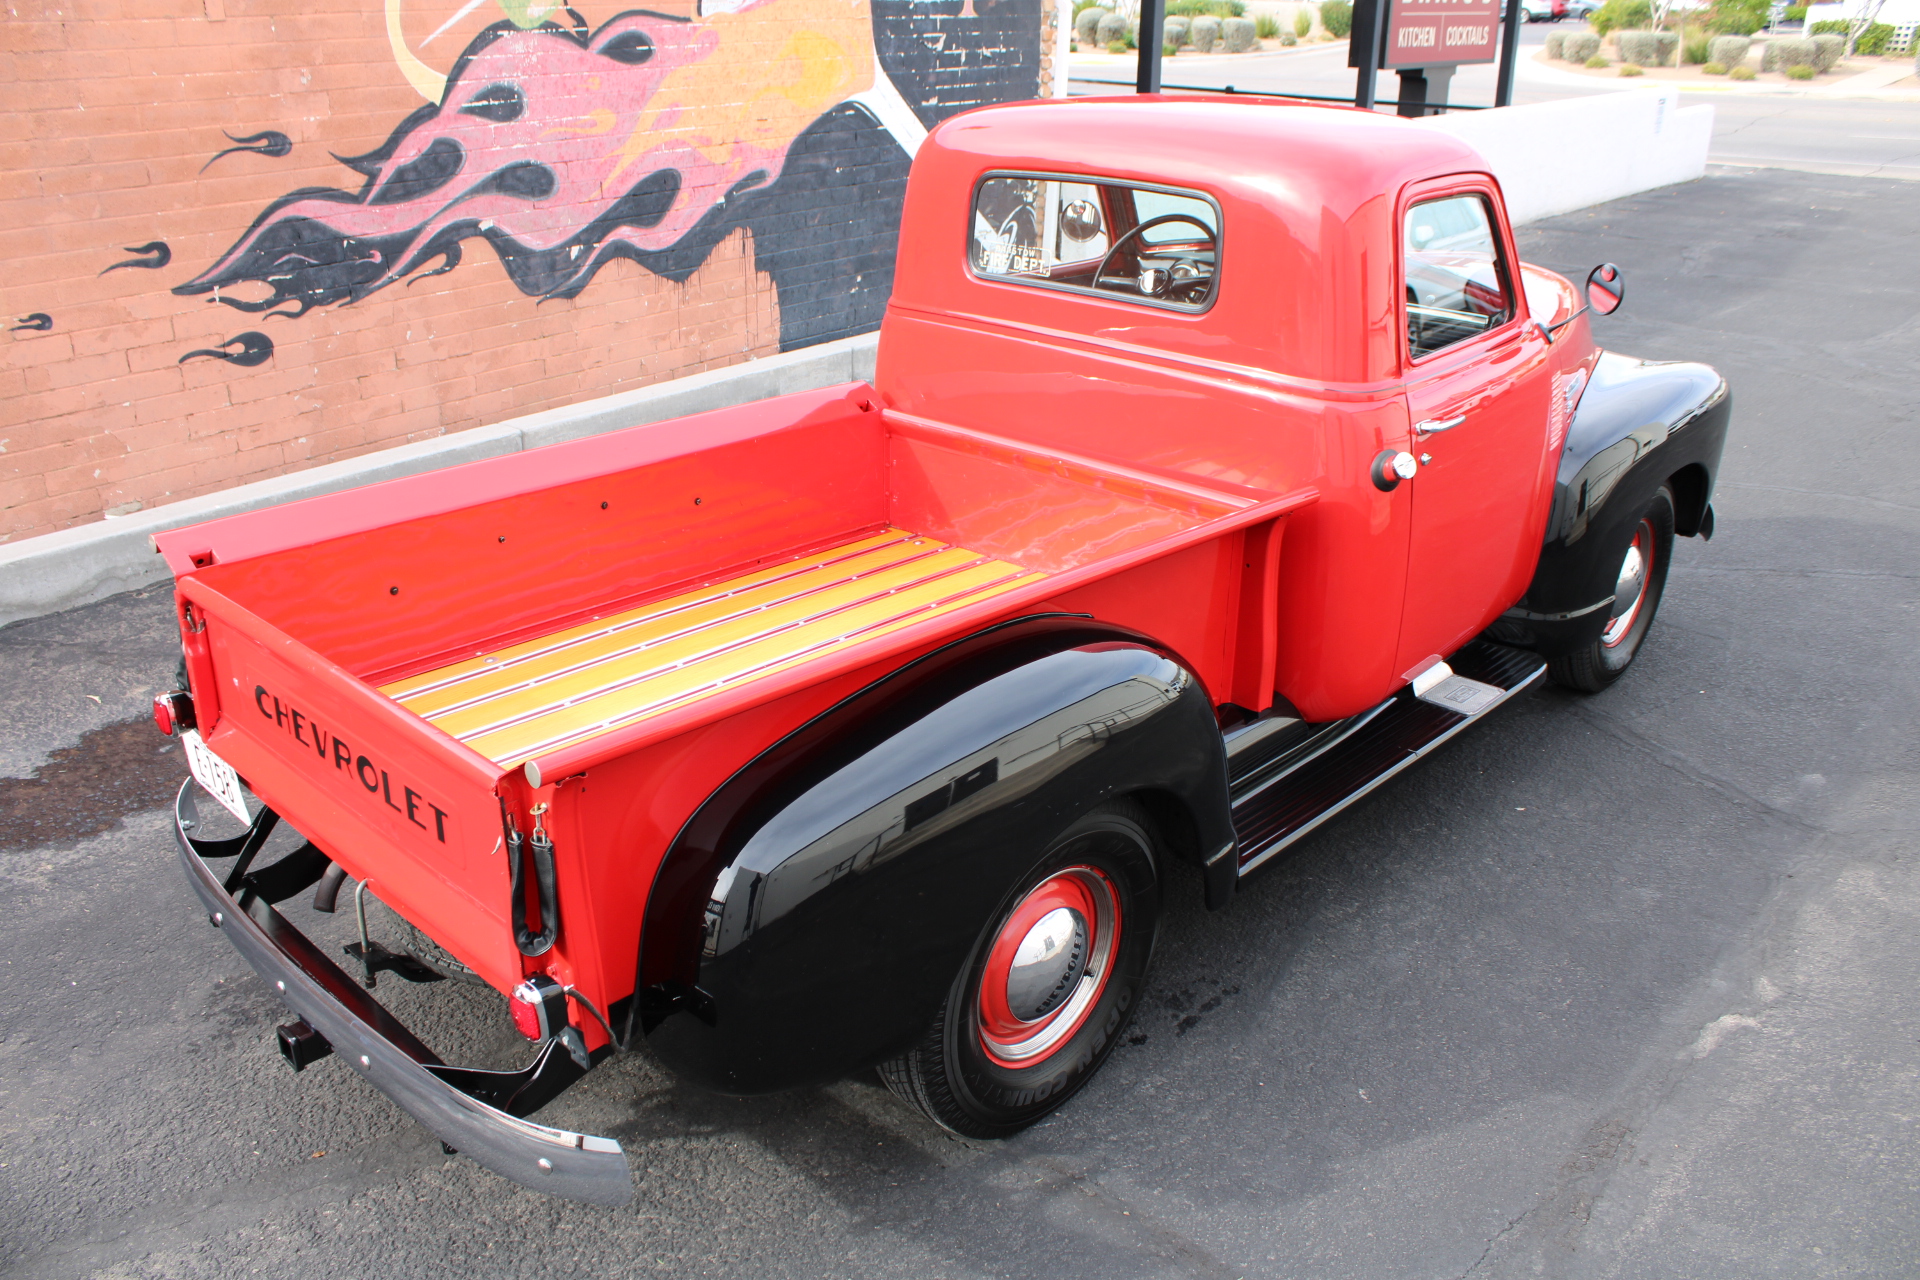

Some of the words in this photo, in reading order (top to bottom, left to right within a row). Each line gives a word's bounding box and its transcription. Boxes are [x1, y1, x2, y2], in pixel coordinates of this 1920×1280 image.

[1397, 26, 1436, 48] KITCHEN
[1445, 25, 1490, 46] COCKTAILS
[983, 250, 1009, 267] FIRE
[254, 684, 449, 845] CHEVROLET
[1034, 928, 1083, 1014] CHEVROLET
[1076, 985, 1132, 1074] OPEN
